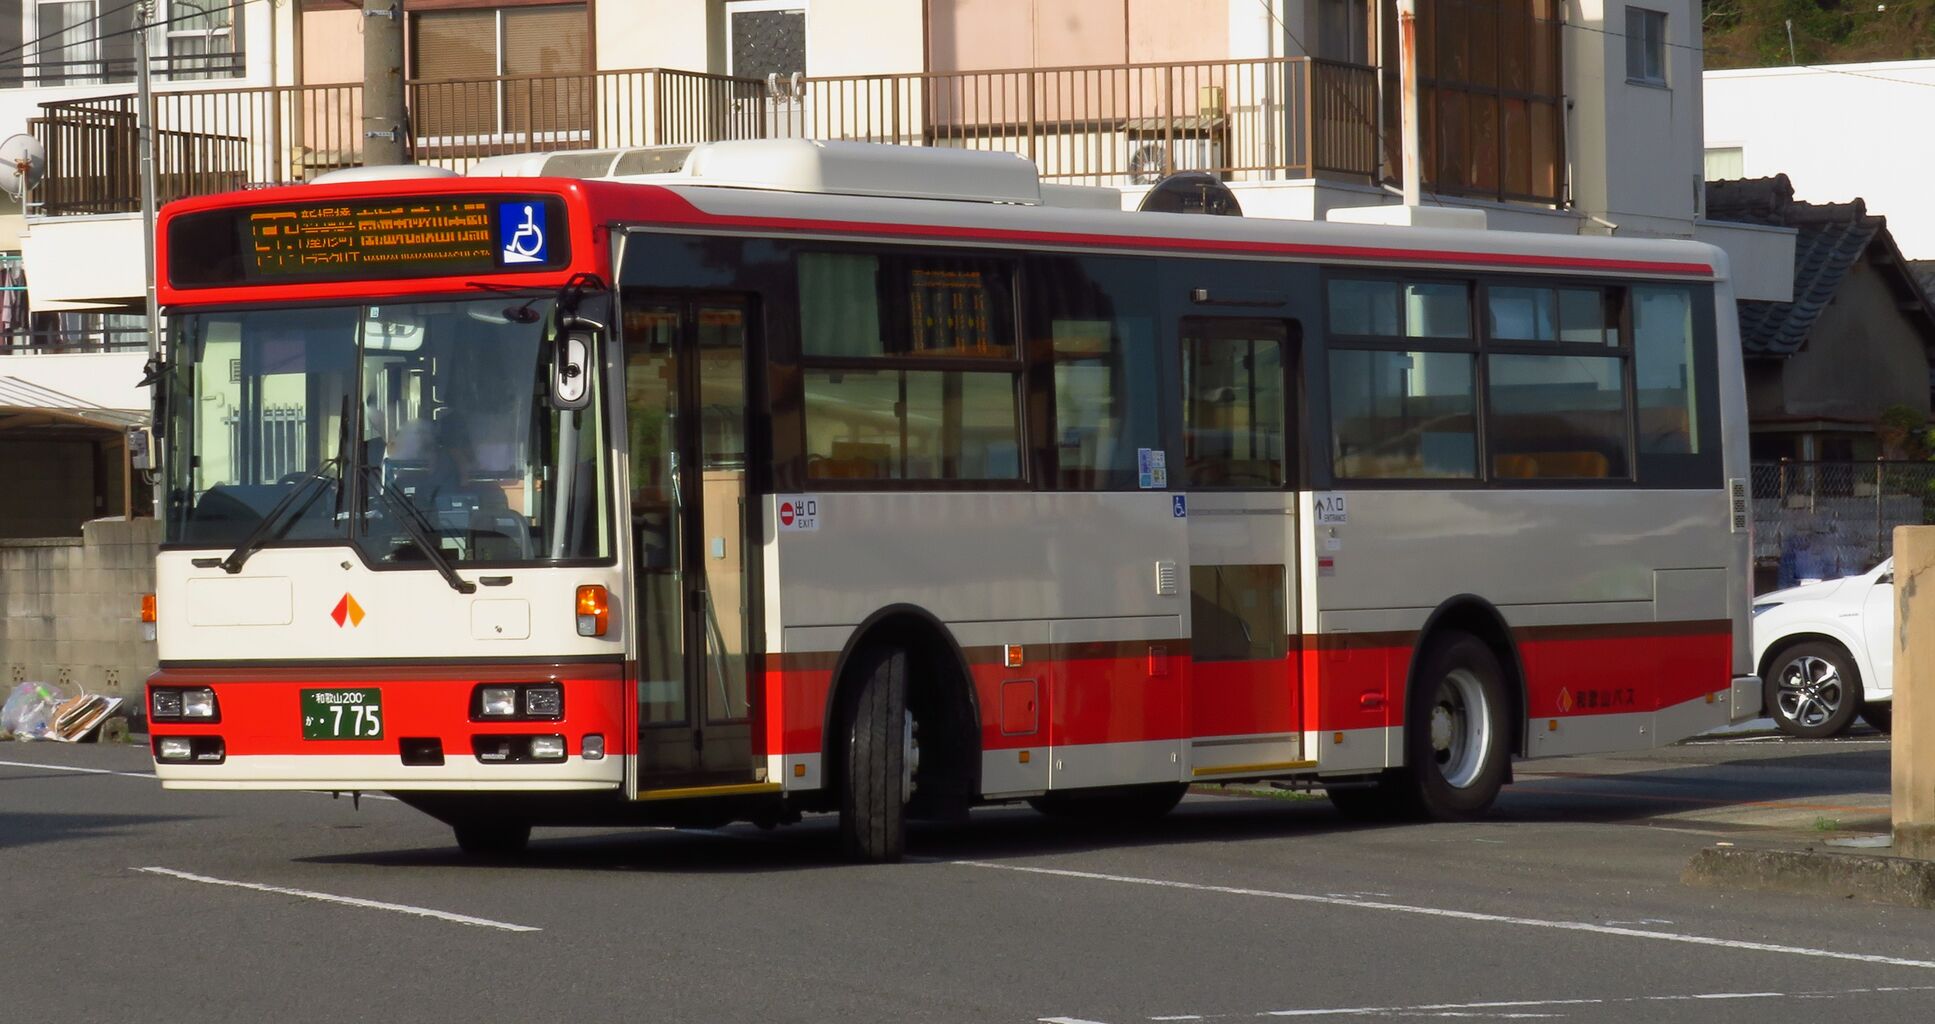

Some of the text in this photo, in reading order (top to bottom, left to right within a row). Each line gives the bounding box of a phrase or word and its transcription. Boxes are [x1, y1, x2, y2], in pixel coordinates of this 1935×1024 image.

[795, 500, 816, 516] 出口
[1326, 497, 1344, 511] 入口
[798, 519, 814, 528] EXIT
